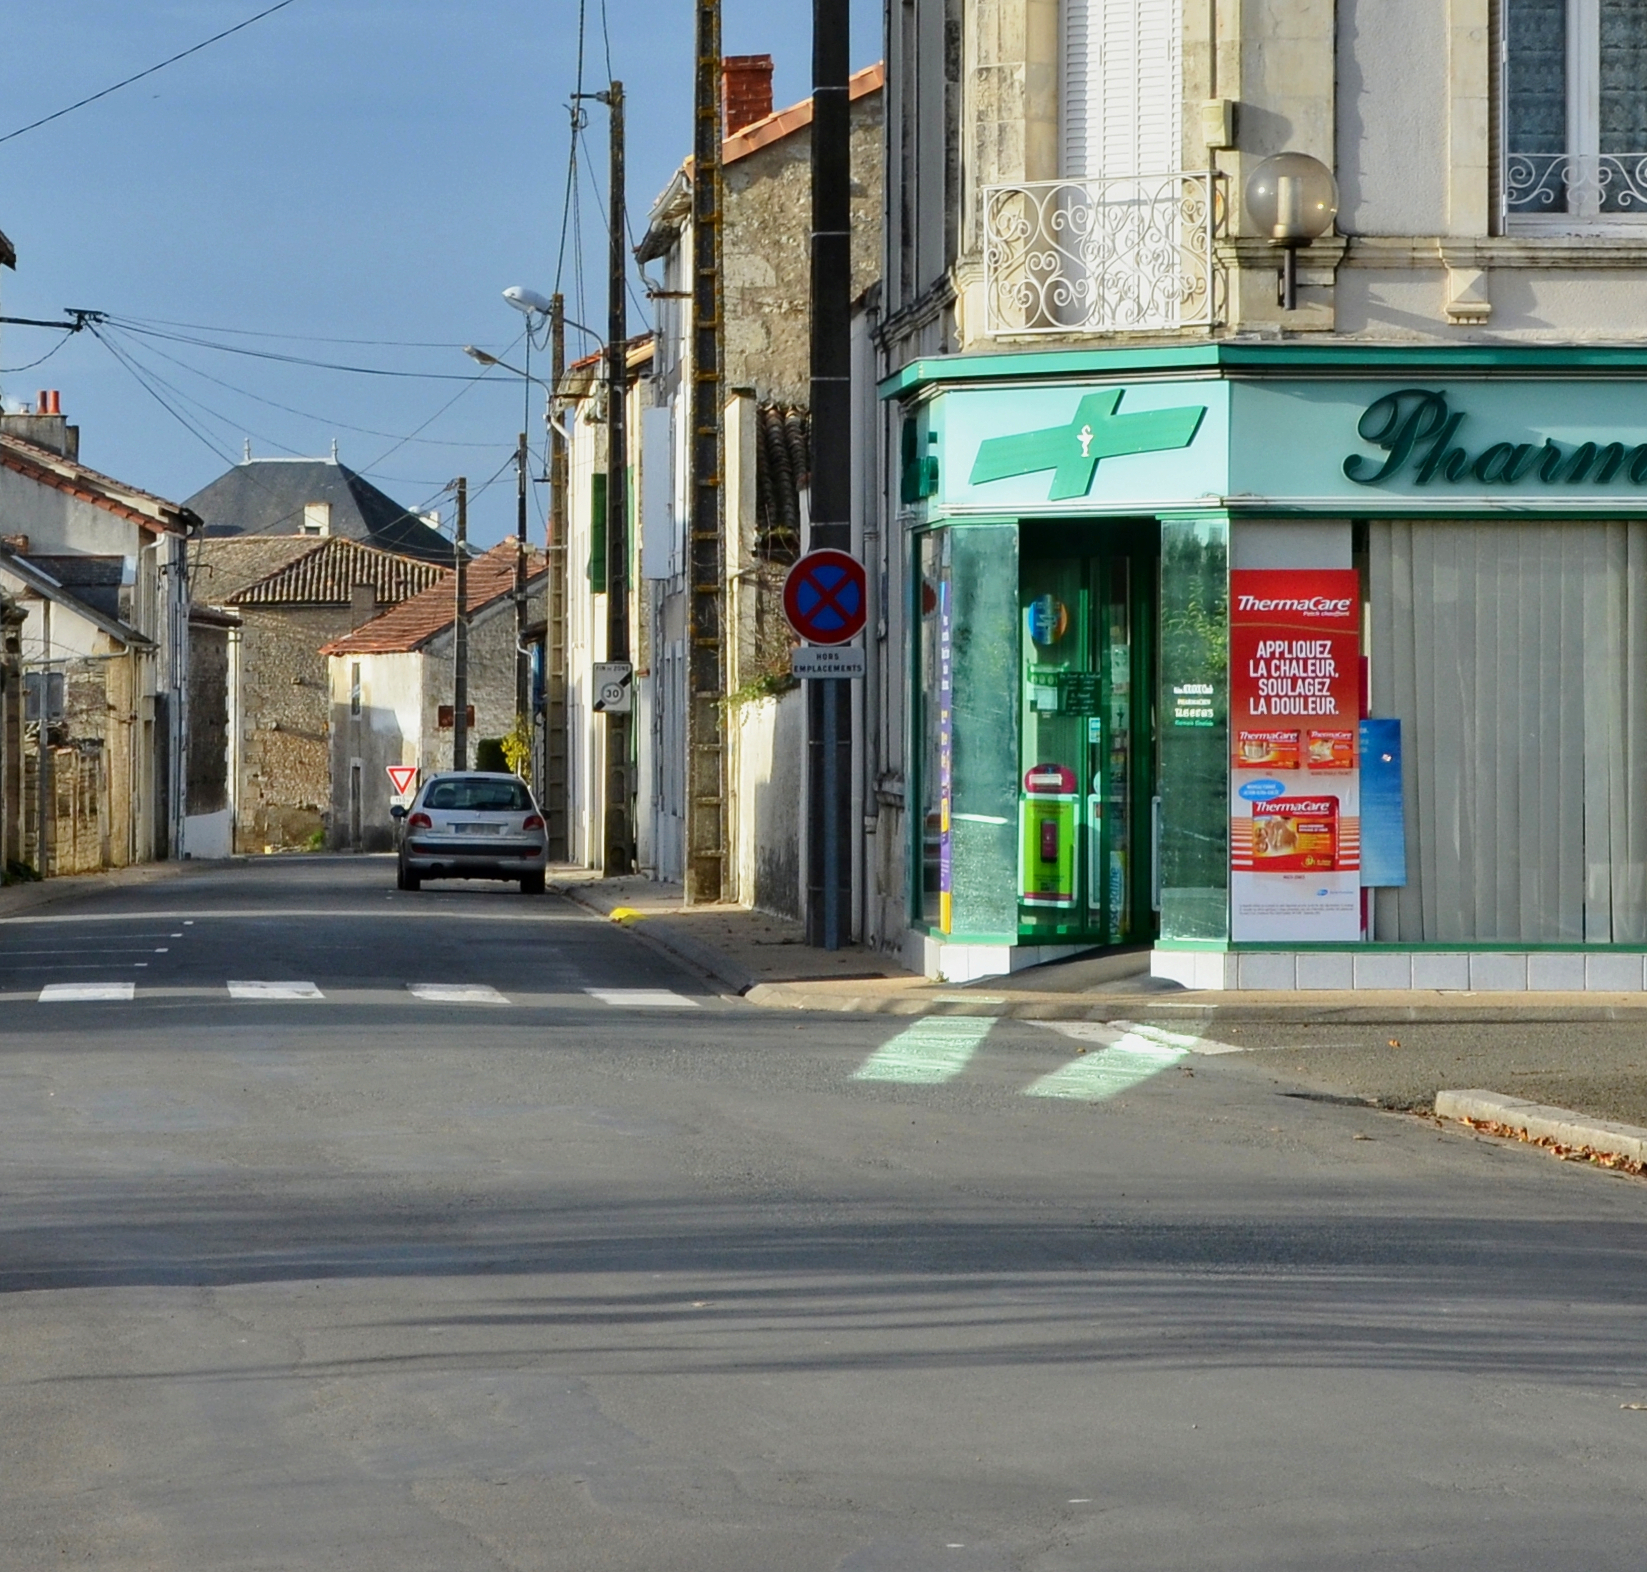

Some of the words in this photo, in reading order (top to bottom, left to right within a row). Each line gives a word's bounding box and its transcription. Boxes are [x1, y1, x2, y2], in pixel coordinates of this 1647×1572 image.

[1237, 595, 1351, 611] ThermaCare
[1256, 640, 1332, 658] APPLIQUEZ
[794, 664, 862, 673] EMPLACEMENTS
[1249, 659, 1270, 677] LA
[1270, 659, 1339, 679] CHALEUR,
[606, 689, 619, 698] 30
[1258, 678, 1331, 696] SOULAGEZ
[1249, 697, 1270, 715] LA
[1270, 697, 1340, 715] DOULEUR.
[1255, 801, 1330, 812] ThermaCare
